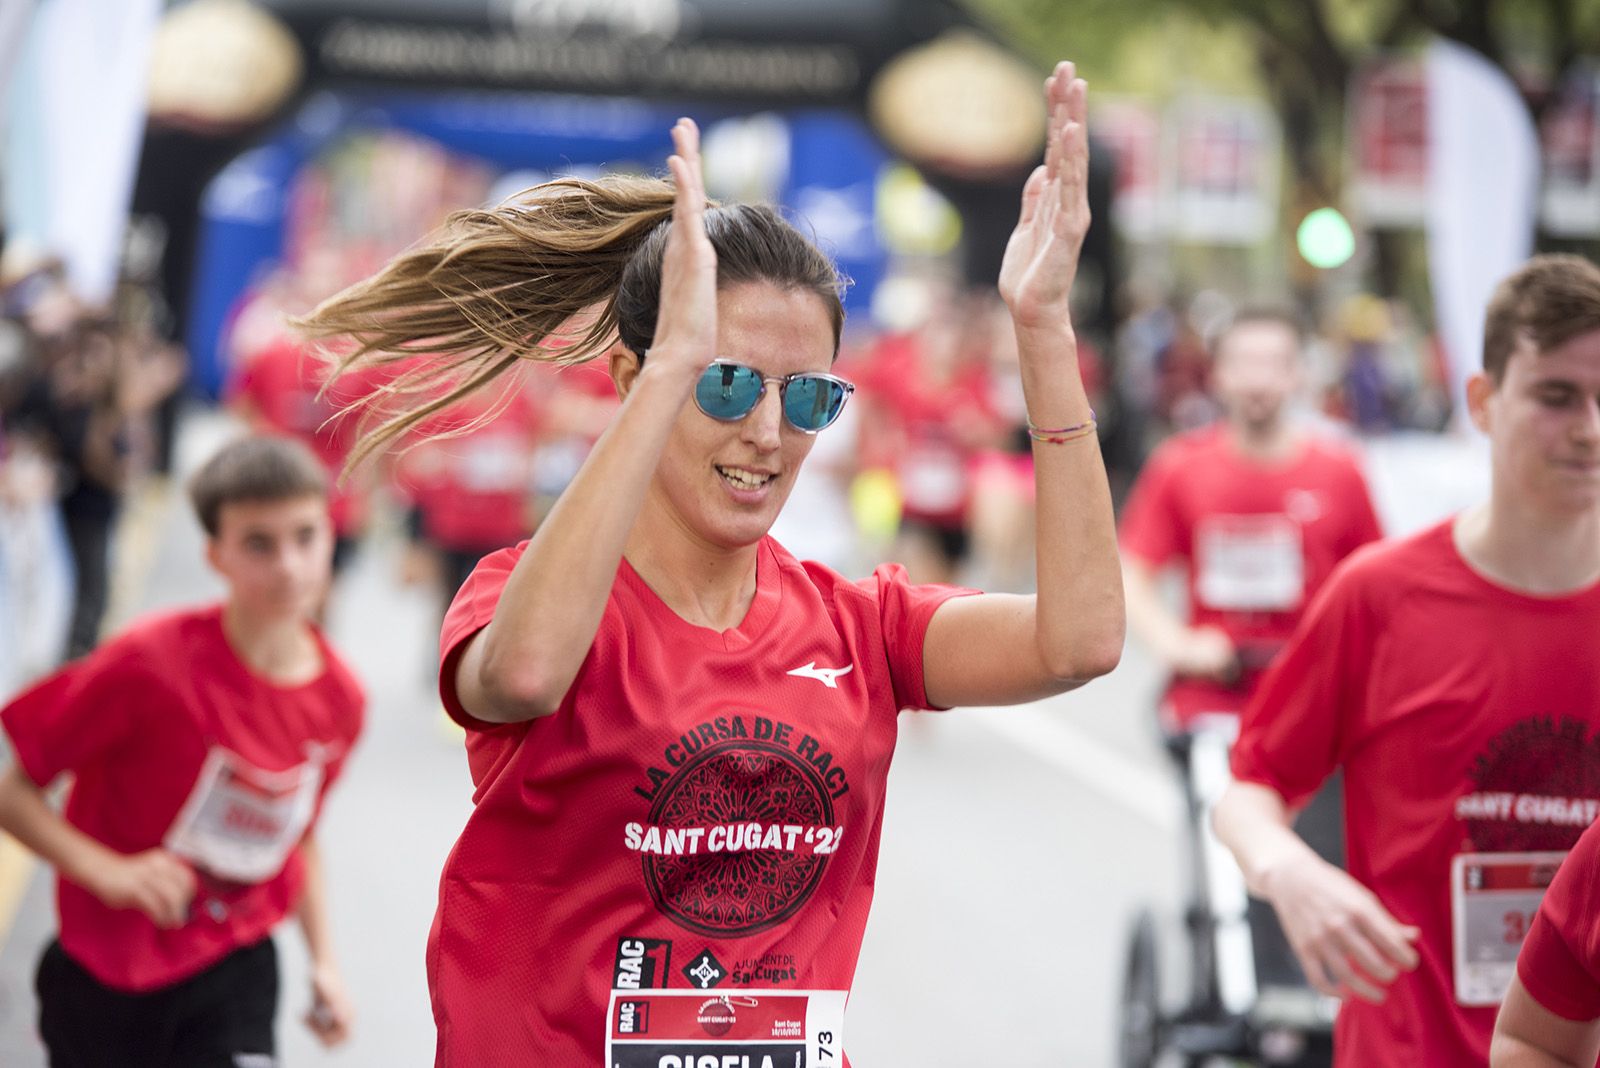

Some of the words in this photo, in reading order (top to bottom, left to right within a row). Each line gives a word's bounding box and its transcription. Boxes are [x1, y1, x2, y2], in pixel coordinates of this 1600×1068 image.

[633, 768, 669, 800] LA
[664, 716, 749, 767] CURSA
[753, 716, 794, 746] DE
[797, 734, 849, 800] RAC1
[624, 822, 704, 855] SANT
[707, 823, 803, 852] CUGAT
[755, 966, 797, 983] Cugat
